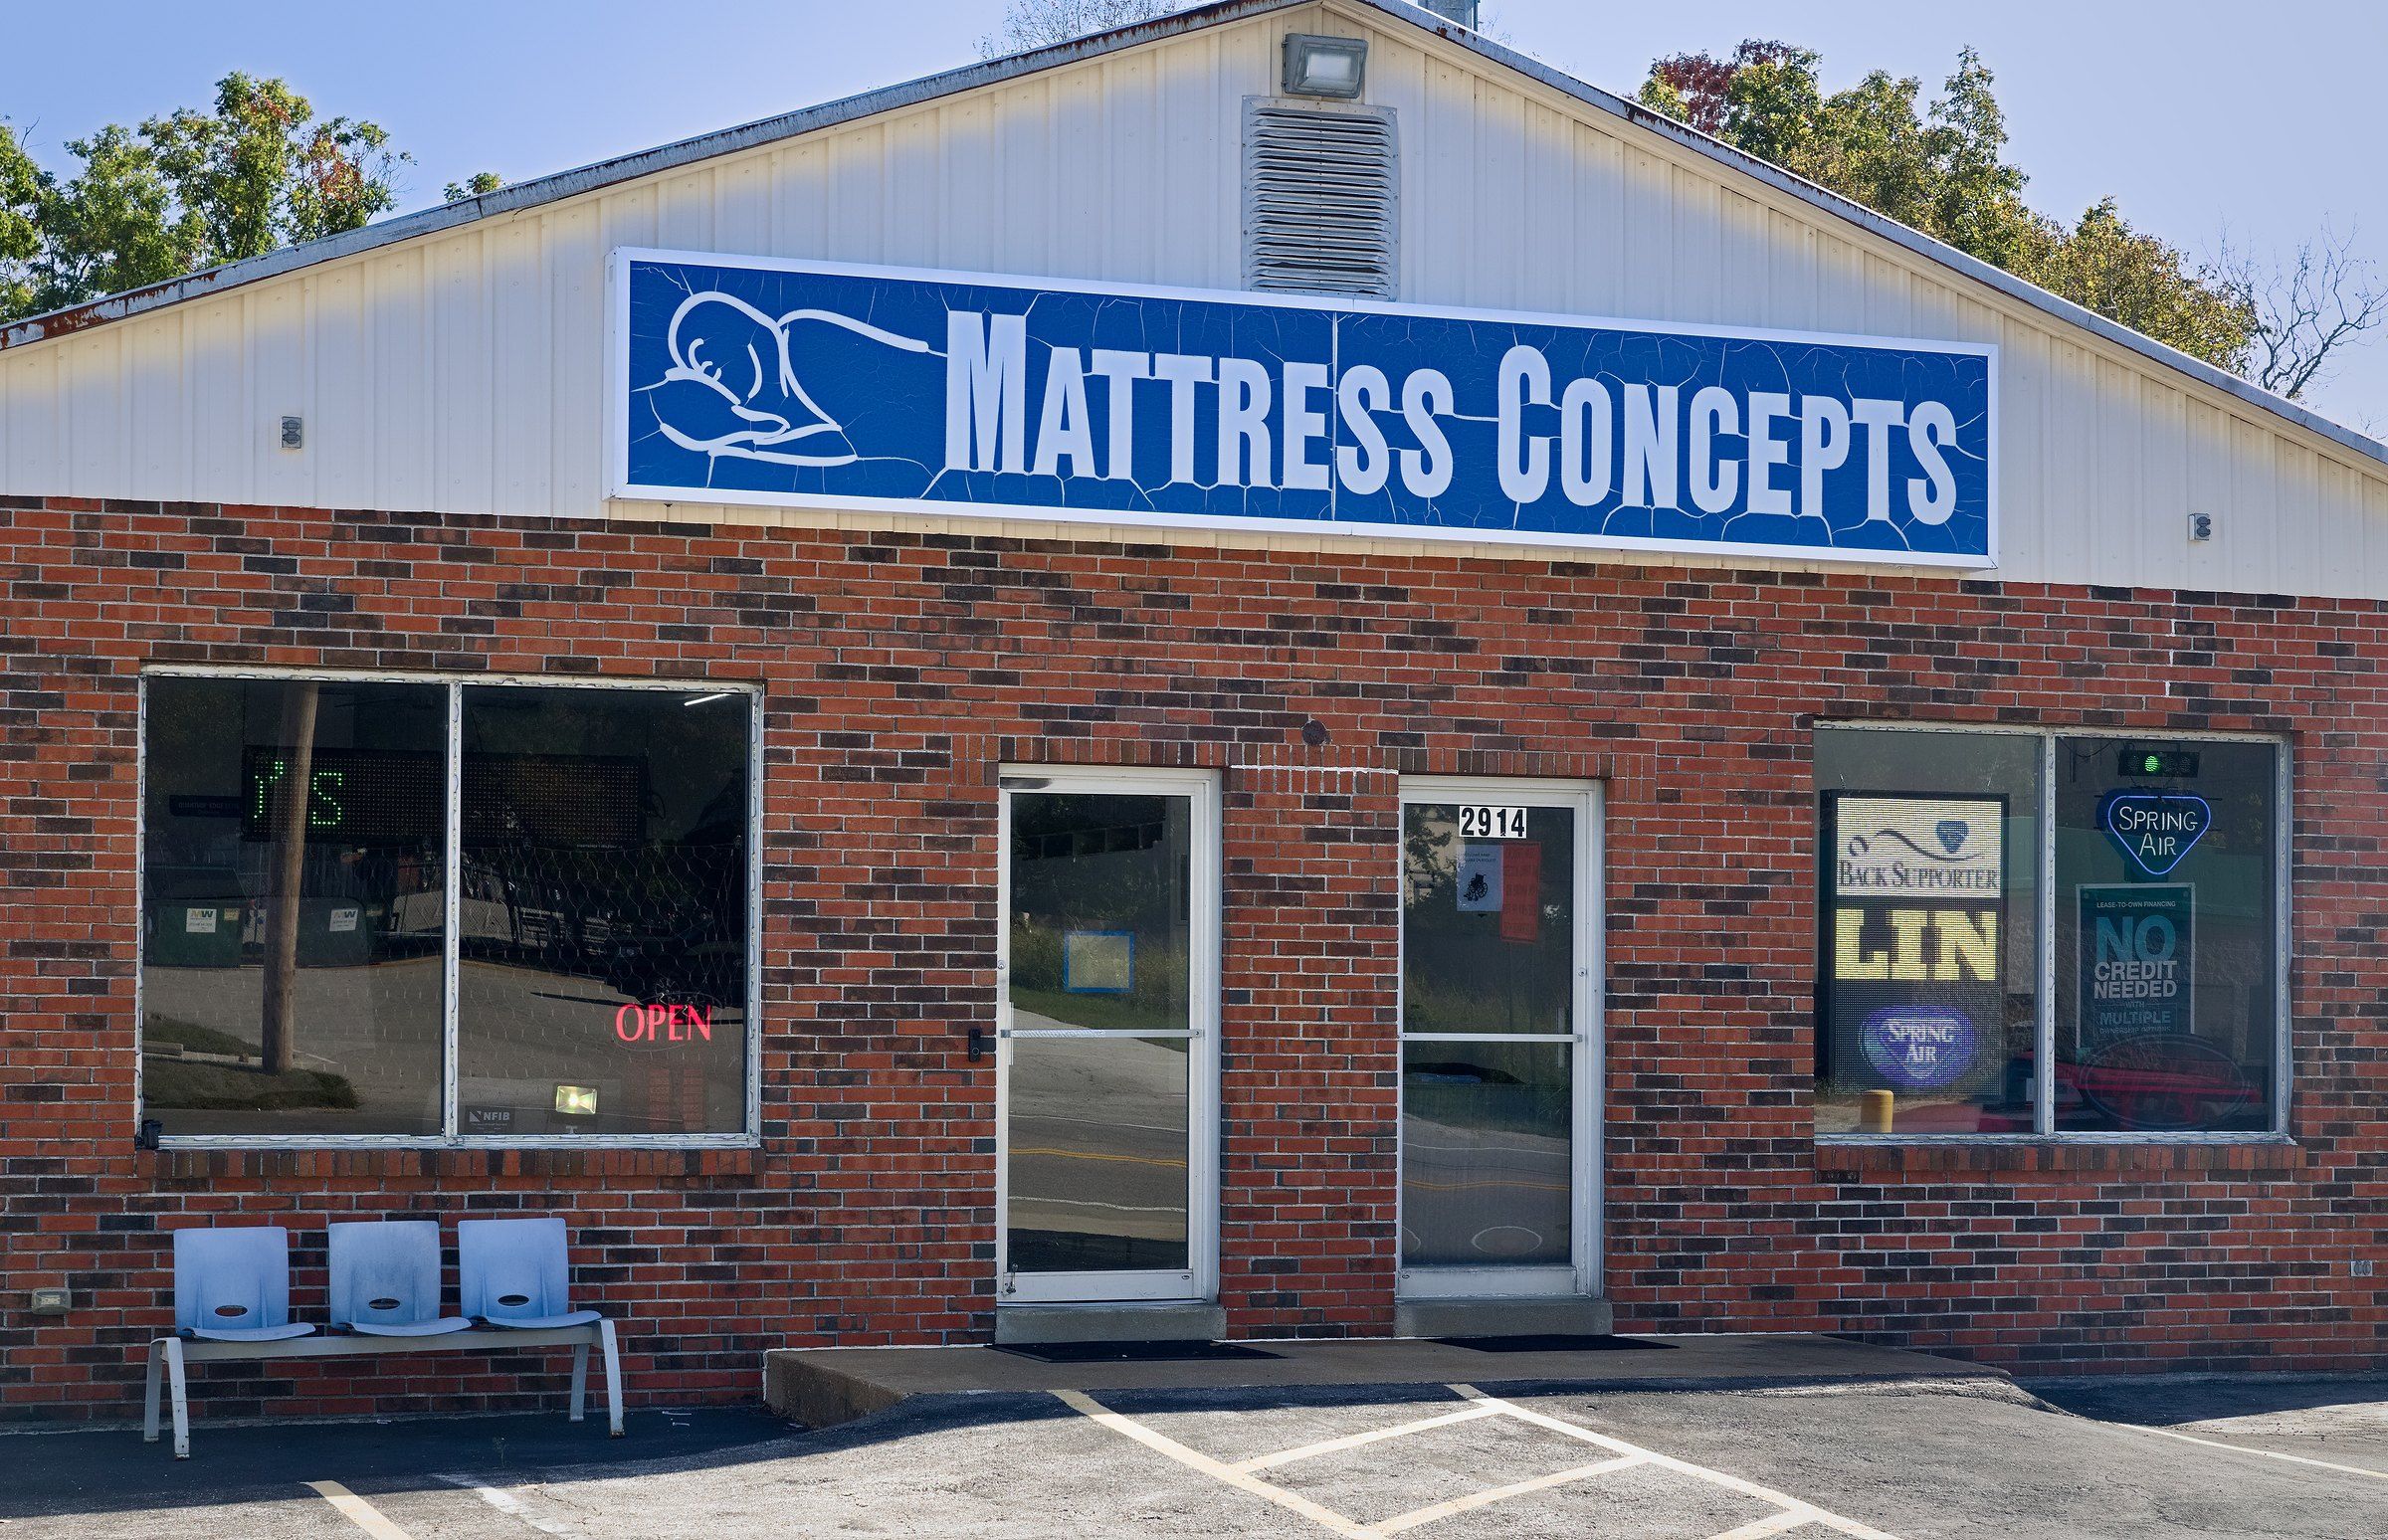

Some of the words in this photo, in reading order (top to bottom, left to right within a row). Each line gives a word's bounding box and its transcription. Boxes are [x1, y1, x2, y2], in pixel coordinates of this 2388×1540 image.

[945, 309, 1455, 498] MATTRESS
[1497, 344, 1958, 526] CONCEPTS
[1461, 807, 1525, 838] 2914
[2119, 806, 2198, 832] SPRING
[2138, 833, 2177, 857] AIR
[1840, 860, 1891, 887] BACK
[1891, 860, 2000, 889] SUPPORTER
[2096, 900, 2143, 909] LEASE-TO-OWN
[1835, 907, 1997, 981] LIN
[2095, 914, 2176, 963] NO
[2093, 960, 2178, 981] CREDIT
[2093, 979, 2177, 999] NEEDED
[615, 1003, 712, 1042] OPEN
[2098, 1010, 2171, 1026] MULTIPLE
[1888, 1020, 1955, 1043] SPRING
[1906, 1043, 1938, 1062] AIR
[483, 1111, 510, 1121] NFIB
